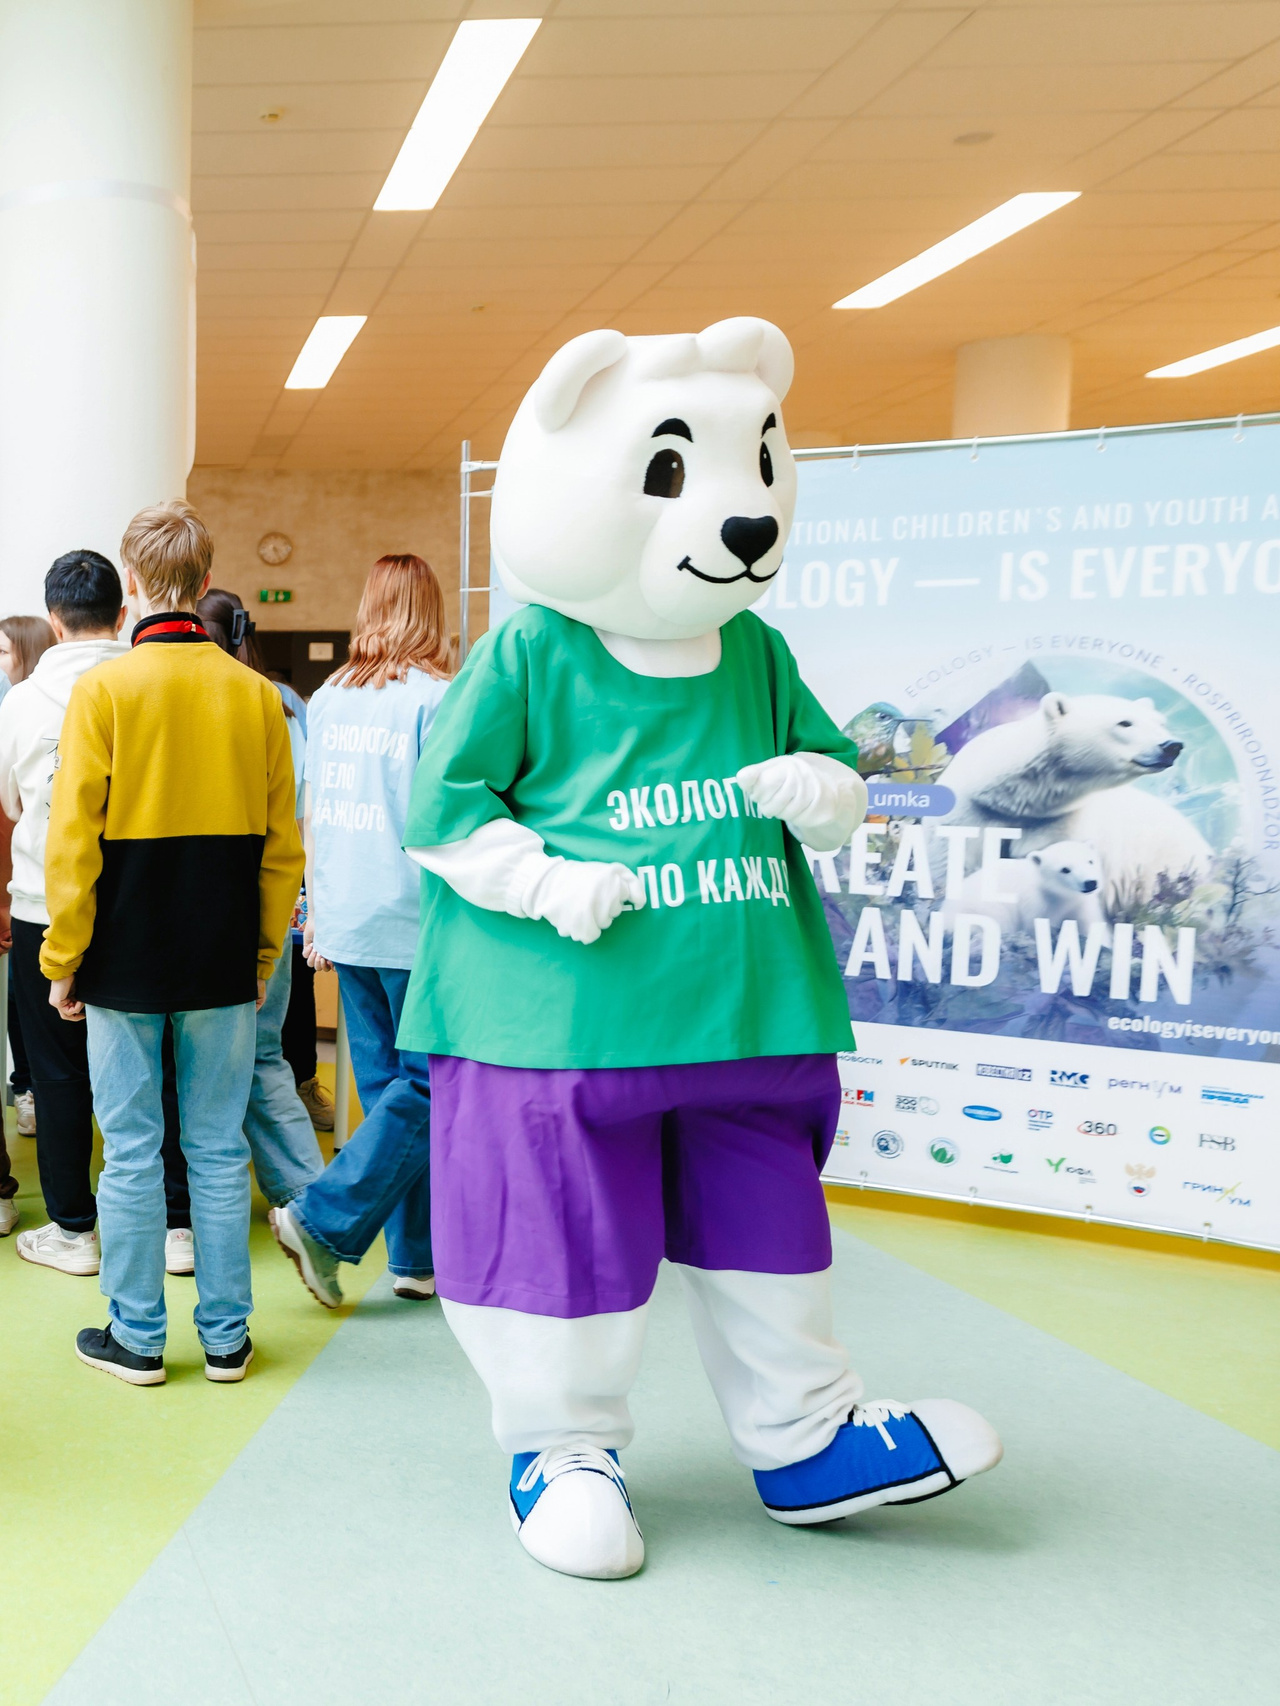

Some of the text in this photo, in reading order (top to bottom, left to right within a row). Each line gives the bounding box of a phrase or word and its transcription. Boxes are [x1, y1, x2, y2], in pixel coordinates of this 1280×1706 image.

[786, 517, 883, 546] TIONAL
[1071, 502, 1132, 532] AND
[1144, 494, 1249, 527] YOUTH
[999, 550, 1050, 602] IS
[904, 644, 993, 699] ECOLOGY
[1025, 637, 1044, 650] IS
[1049, 634, 1165, 671] EVERYONE
[607, 776, 763, 832] ЭКОЛОГ
[844, 907, 1197, 1006] AND WIN
[1082, 1120, 1118, 1136] 360
